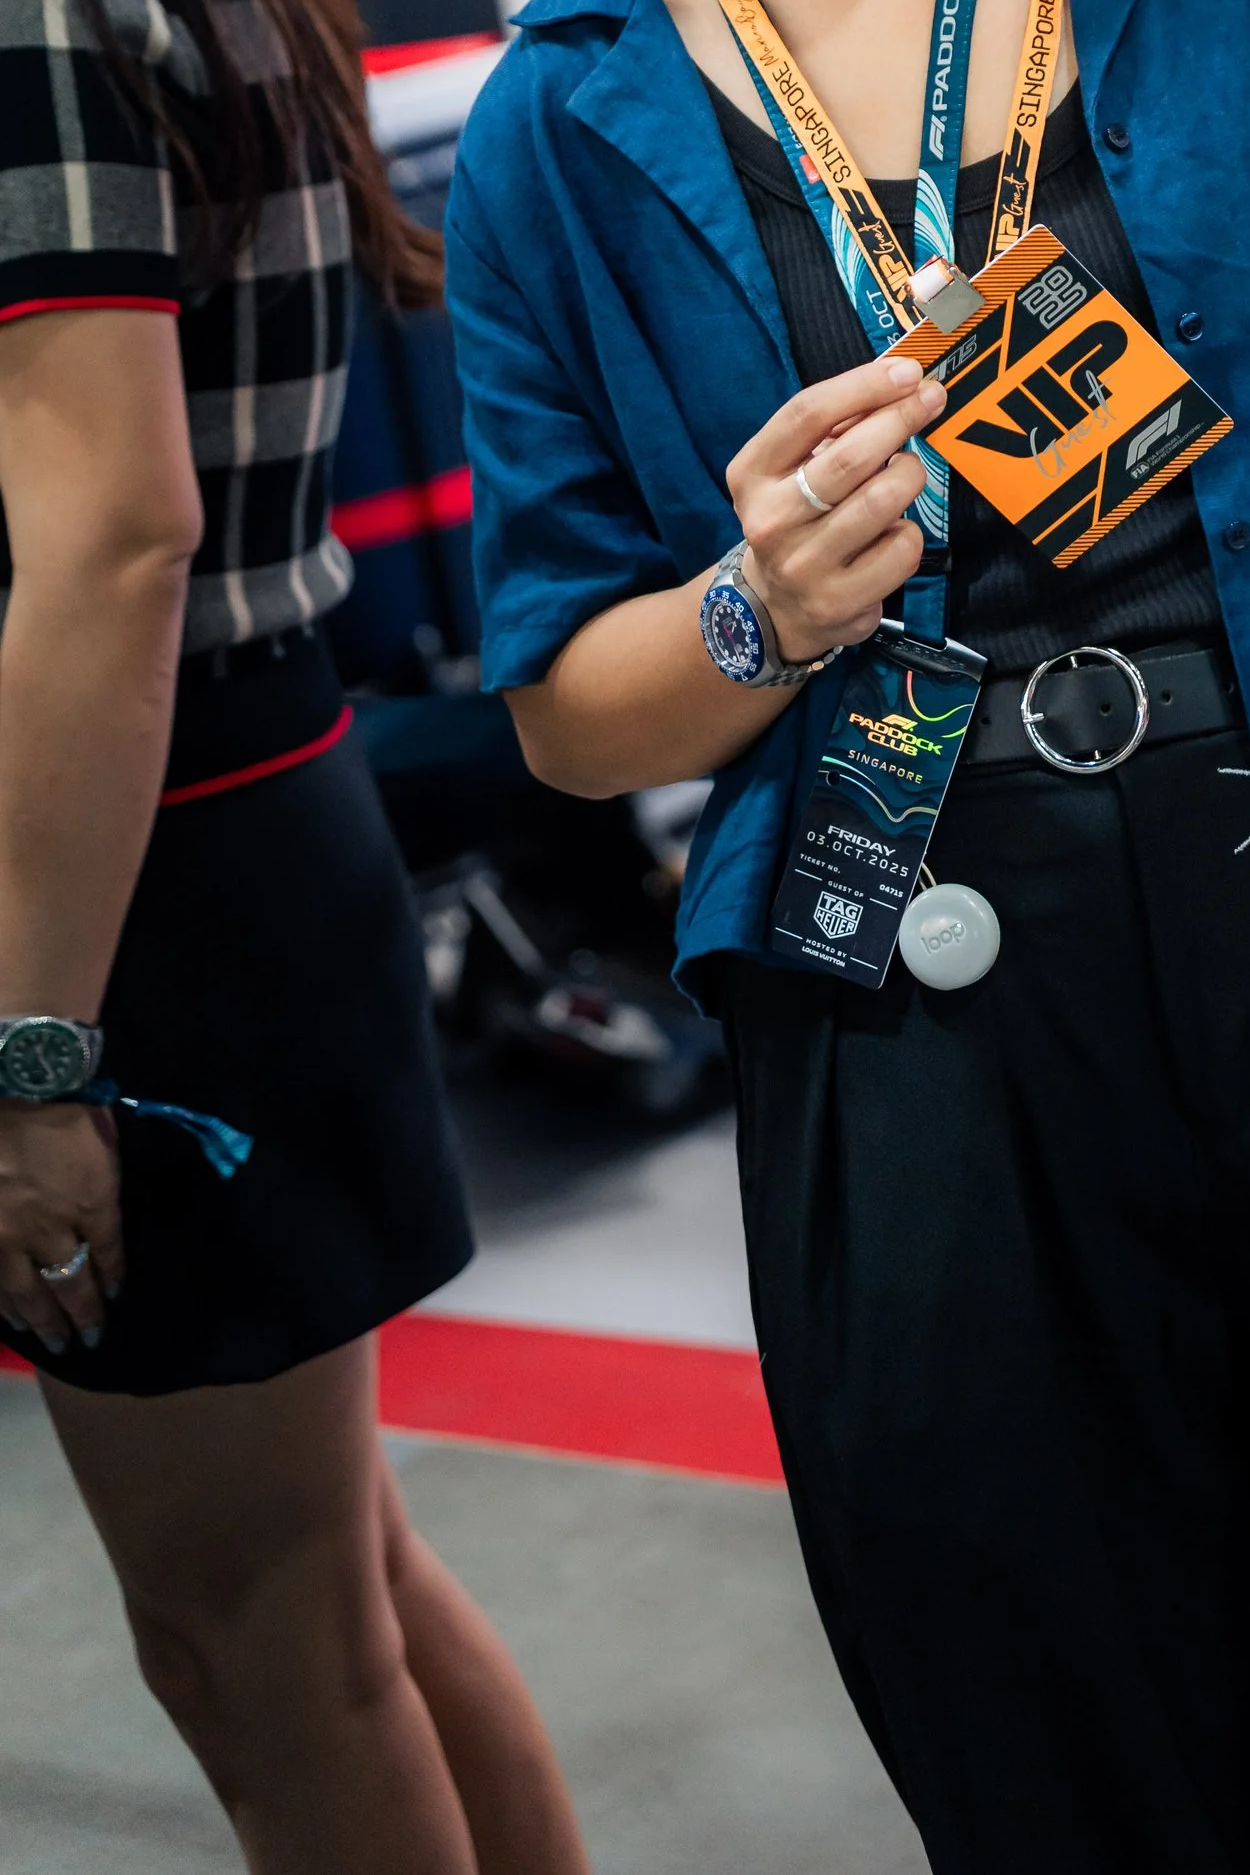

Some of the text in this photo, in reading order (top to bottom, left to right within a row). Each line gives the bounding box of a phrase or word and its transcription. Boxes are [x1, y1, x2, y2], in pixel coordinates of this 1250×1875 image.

[772, 60, 852, 184] SINGAPORE
[1002, 172, 1027, 216] Guest
[859, 217, 897, 256] Guest
[866, 289, 895, 328] OCT
[957, 320, 1129, 460] VIP
[1029, 369, 1118, 482] Guest
[735, 602, 745, 613] 40
[746, 620, 756, 633] 45
[848, 712, 944, 756] PADDOCK
[867, 731, 919, 757] CLUB
[848, 749, 924, 785] SINGAPORE
[806, 831, 909, 877] 03.OCT.2025
[827, 825, 896, 857] FRIDAY
[800, 853, 827, 868] TICKET
[828, 880, 864, 898] GUEST OF
[879, 883, 904, 898] 04715
[816, 909, 855, 936] HEUER
[823, 895, 859, 920] TAG
[806, 938, 848, 959] HOSTED BY
[921, 921, 966, 956] loop
[802, 945, 846, 968] LOUIS VUITTON
